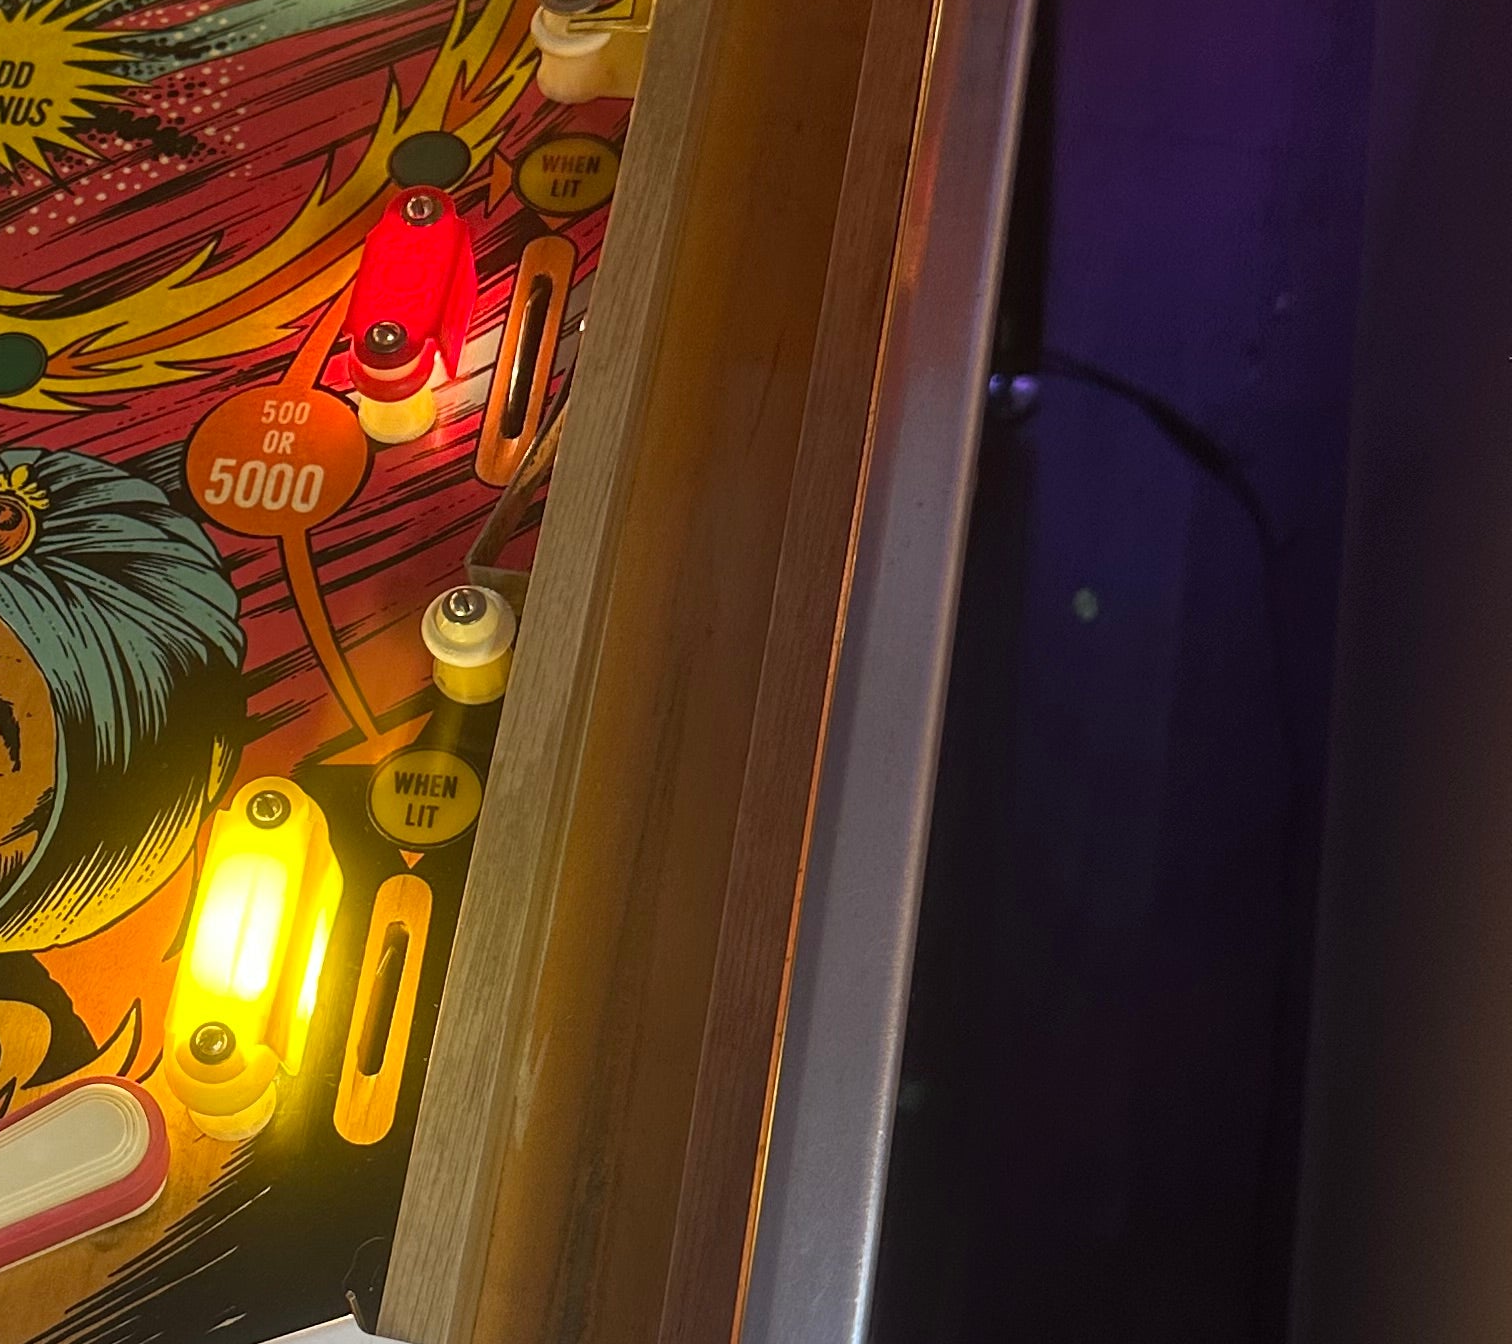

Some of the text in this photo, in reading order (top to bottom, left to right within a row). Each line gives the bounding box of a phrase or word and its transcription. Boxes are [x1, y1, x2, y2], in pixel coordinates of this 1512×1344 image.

[541, 154, 602, 175] WHEN
[550, 178, 583, 198] LIT
[260, 399, 312, 426] 500
[262, 429, 296, 455] OR
[204, 457, 325, 514] 5000
[393, 770, 459, 800] WHEN
[404, 802, 441, 829] LIT
